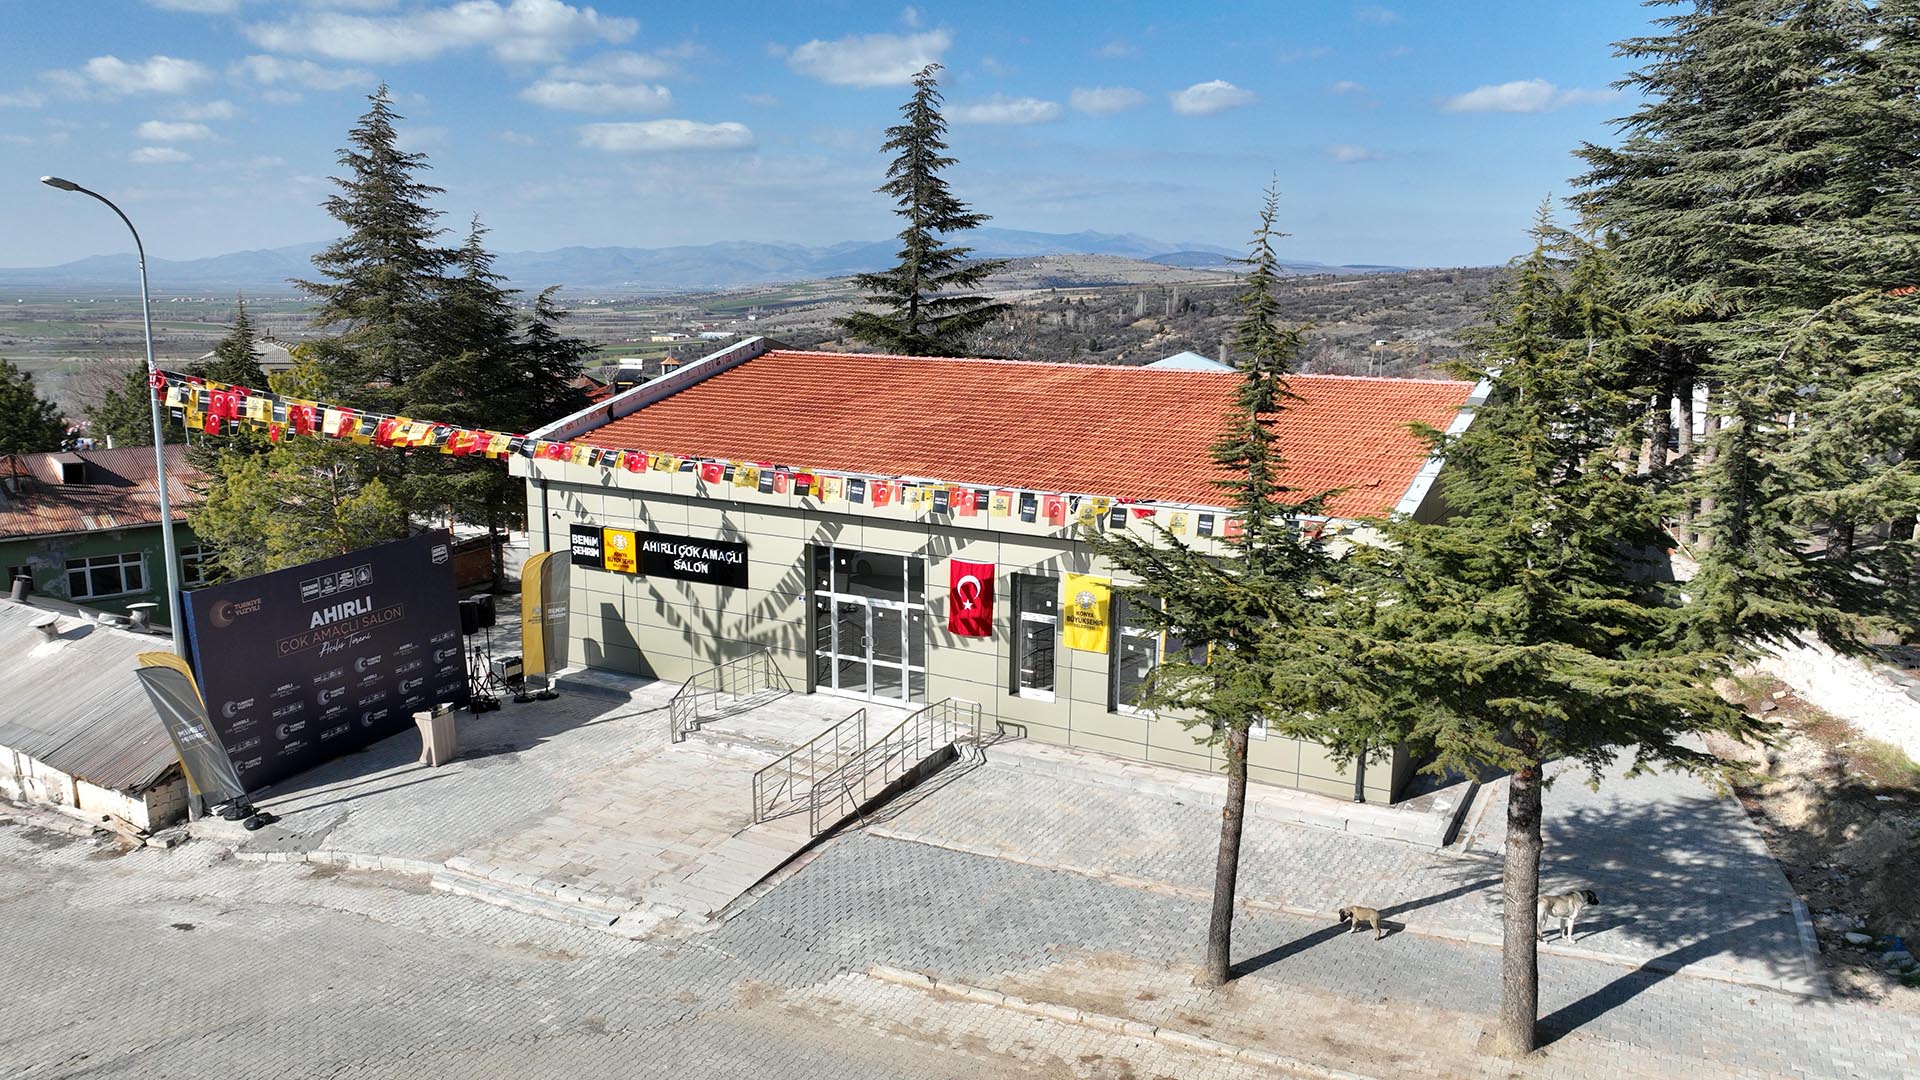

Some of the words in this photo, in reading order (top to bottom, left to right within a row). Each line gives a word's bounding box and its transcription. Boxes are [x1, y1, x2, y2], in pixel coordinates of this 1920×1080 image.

[642, 540, 677, 555] AHIRLI
[679, 544, 700, 559] ÇOK
[701, 548, 743, 564] AMAÇLI
[673, 559, 709, 574] SALON
[310, 595, 373, 629] AHIRLI
[1076, 610, 1094, 618] KONYA
[280, 635, 309, 655] ÇOK
[312, 620, 359, 644] AMAÇLI
[362, 606, 402, 627] SALON
